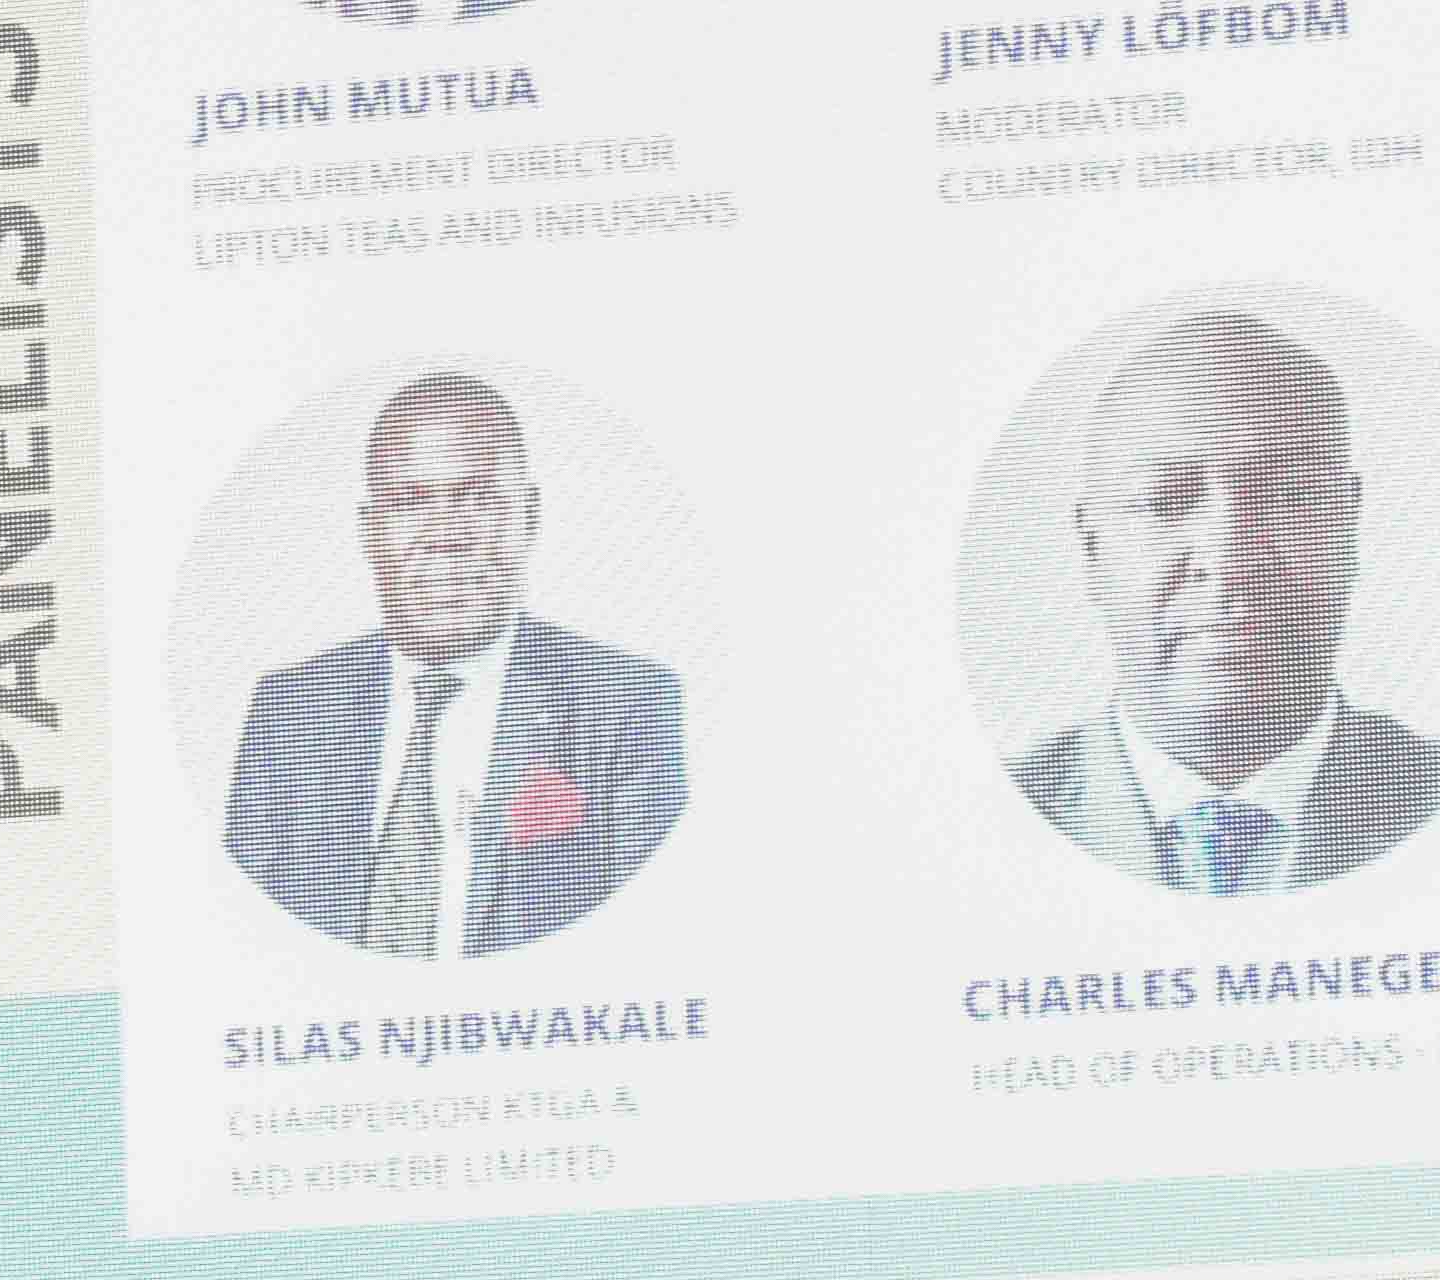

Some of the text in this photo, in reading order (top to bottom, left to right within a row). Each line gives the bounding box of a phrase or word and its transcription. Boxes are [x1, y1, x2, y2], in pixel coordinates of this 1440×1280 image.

[932, 16, 1104, 84] JENNY
[186, 61, 540, 149] JOHN MUTUA
[937, 91, 1186, 144] MODERATOR
[192, 133, 678, 206] PROCUREMENT DIRECTOR
[938, 158, 1121, 203] COUNTRY
[194, 189, 739, 271] LIPTON TEAS AND INFUSIONS
[962, 966, 1198, 1022] CHARLES
[223, 997, 709, 1069] SILAS NJIBWAKALE
[971, 1056, 1076, 1094] HEAD
[1089, 1050, 1138, 1088] OF
[1151, 1032, 1403, 1084] OPERATIONS
[229, 1094, 490, 1139] CHAIRPERSON
[232, 1164, 292, 1199] MD
[466, 1143, 615, 1186] LIMITED
